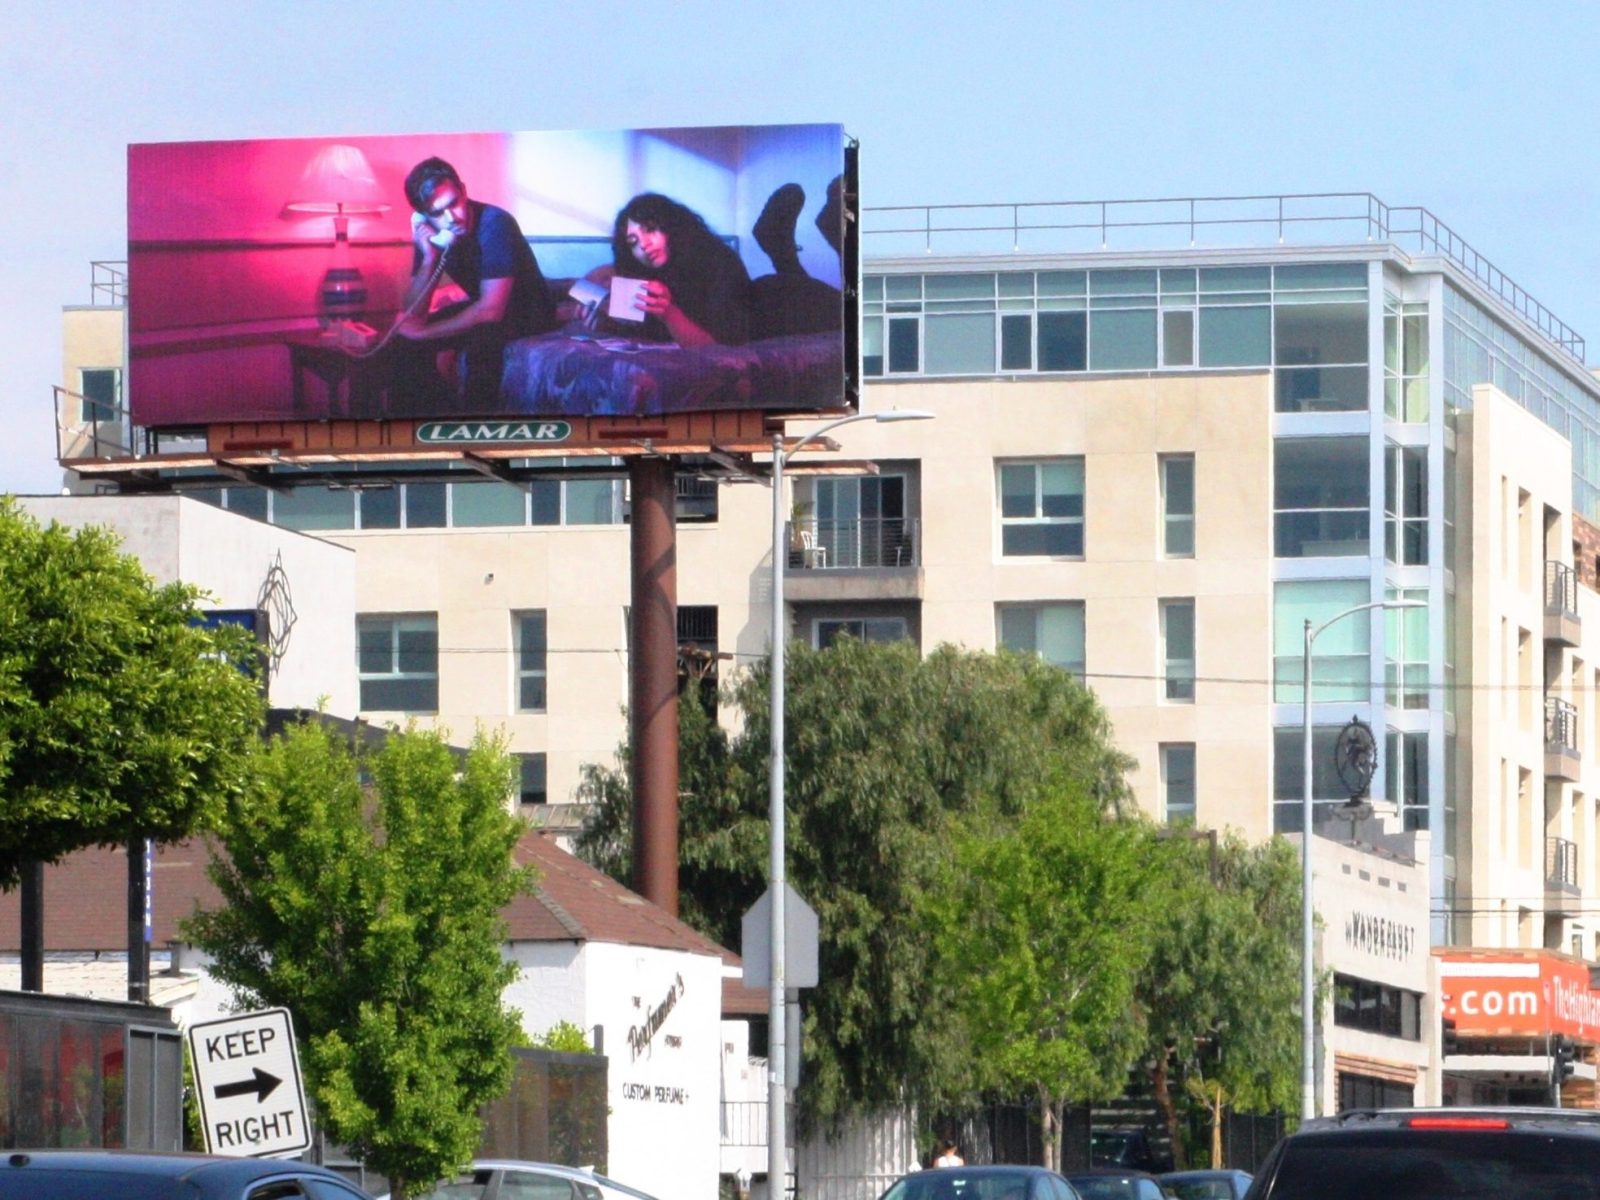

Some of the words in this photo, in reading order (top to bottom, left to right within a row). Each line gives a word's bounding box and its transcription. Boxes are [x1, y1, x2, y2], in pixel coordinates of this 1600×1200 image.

[429, 423, 559, 440] LAMAR
[1440, 990, 1538, 1016] .com
[205, 1027, 276, 1063] KEEP
[622, 1082, 651, 1101] CUSTOM
[654, 1086, 684, 1105] PERFUME
[215, 1110, 294, 1148] RIGHT
